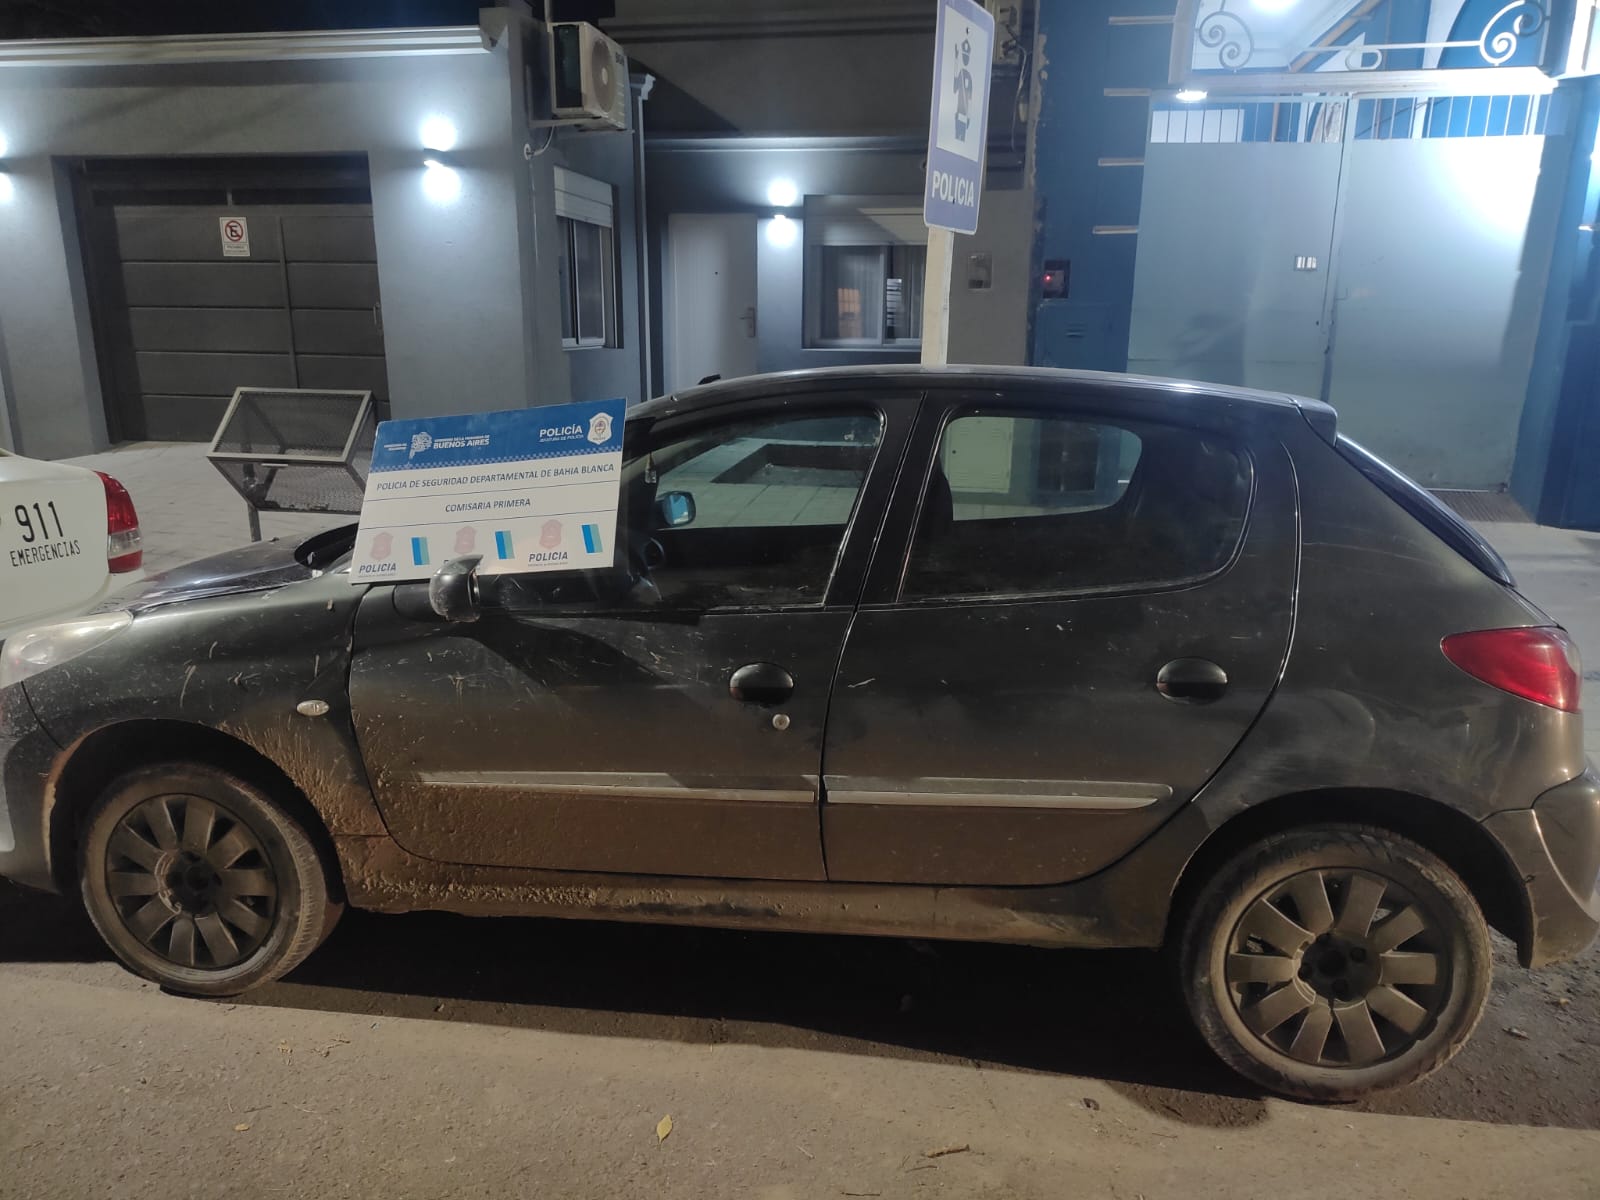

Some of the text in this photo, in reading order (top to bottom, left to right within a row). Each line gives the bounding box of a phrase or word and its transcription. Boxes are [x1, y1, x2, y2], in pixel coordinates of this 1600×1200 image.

[932, 170, 975, 207] POLICIA
[539, 424, 583, 437] POLICÍA
[433, 440, 466, 450] BUENOS
[466, 438, 490, 447] AIRES
[377, 463, 614, 491] POLICIA DE SEGURIDAD DEPARTAMENTAL DE BAHIA BLANCA
[445, 498, 531, 513] COMISARIA PRIMERA
[14, 501, 63, 543] 911
[10, 540, 81, 567] EMERGENCIAS
[528, 551, 568, 562] POLICIA
[359, 563, 397, 574] POLICIA
